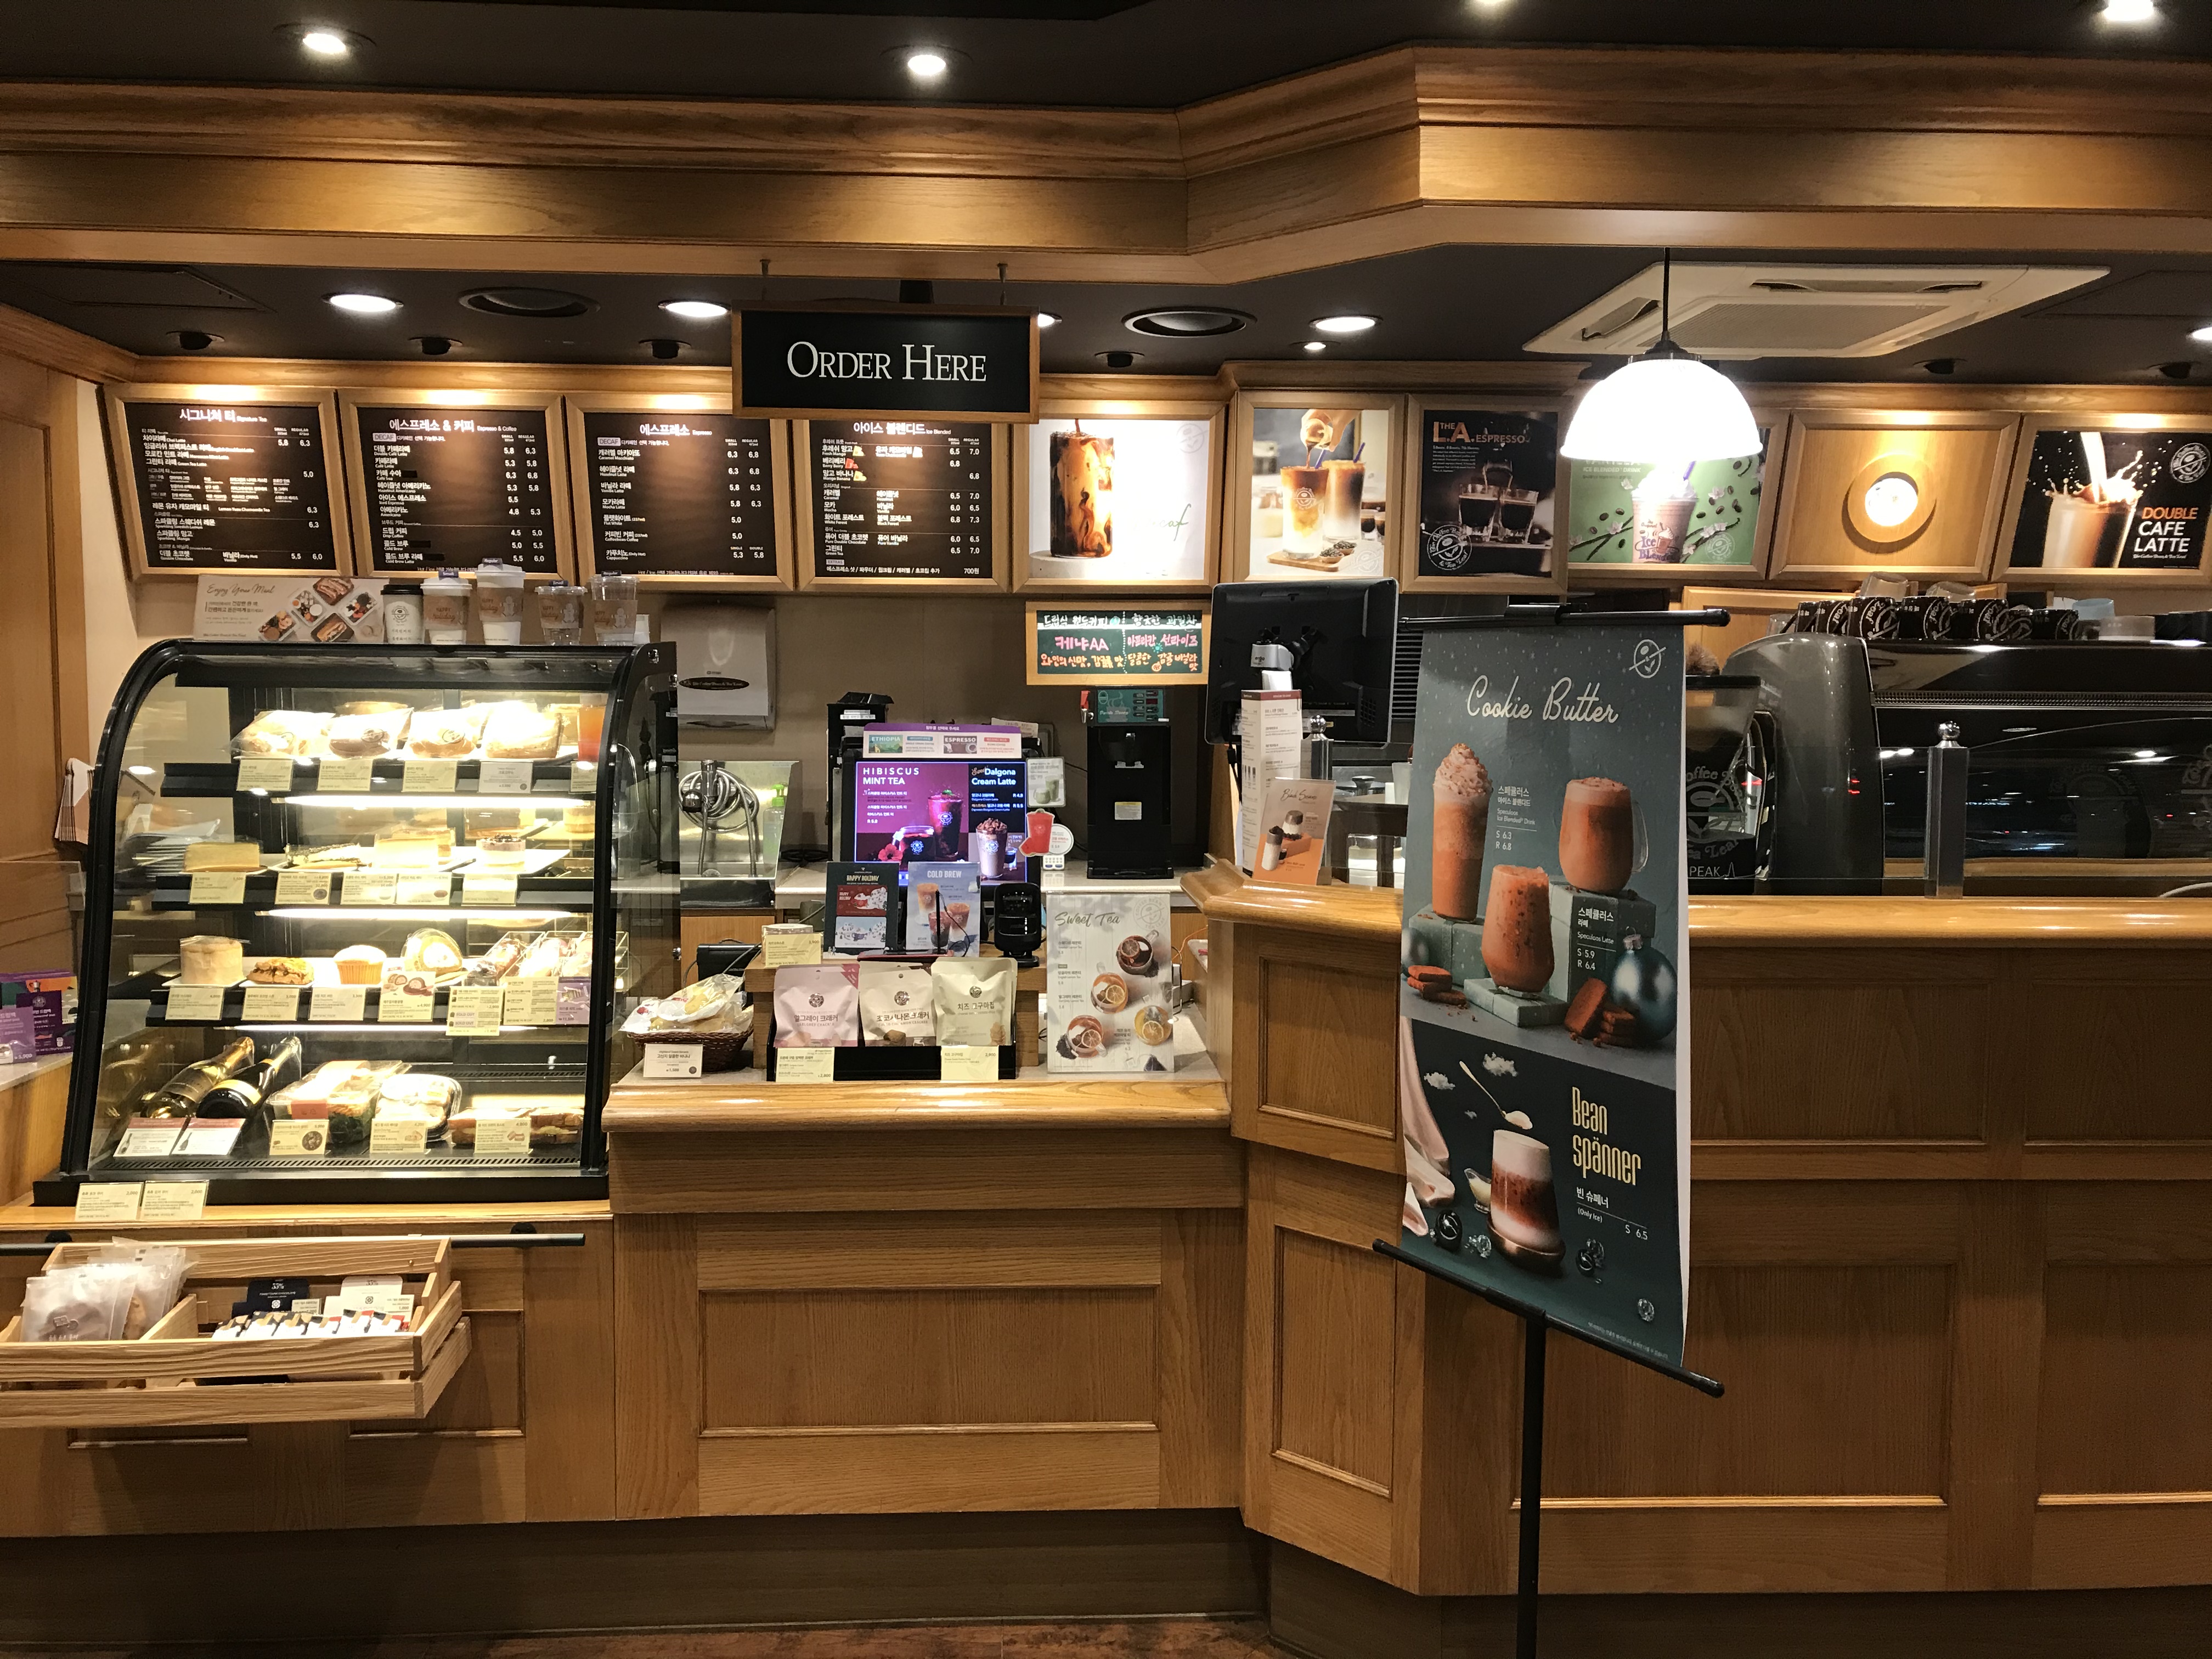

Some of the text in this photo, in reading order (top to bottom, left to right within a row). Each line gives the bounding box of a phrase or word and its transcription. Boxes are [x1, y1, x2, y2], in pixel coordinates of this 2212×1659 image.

[787, 342, 986, 381] ORDER HERE
[180, 409, 235, 422] 시그니처 티
[389, 419, 475, 432] 에스프레소 & 커피
[640, 424, 690, 436] 에스프레소
[854, 422, 883, 434] 아이스
[1476, 435, 1525, 443] ESPRESSO
[2142, 507, 2198, 520] DOUBLE
[2138, 522, 2186, 536] CAFE
[1641, 536, 1656, 548] Ice
[2134, 538, 2190, 552] LATTE
[207, 584, 229, 597] Enjoy
[1043, 615, 1108, 627] 드립식 원두커피
[1166, 614, 1197, 627] 과일차
[1054, 636, 1109, 651] 케냐AA
[1127, 634, 1198, 647] 아프리칸 선라이즈
[1114, 656, 1124, 668] 맛
[1127, 652, 1152, 666] 달콤한
[1175, 653, 1197, 662] 바닐라
[1189, 662, 1198, 671] 맛
[1466, 674, 1619, 724] Cookie Butter
[985, 768, 1015, 776] Dalgona
[1686, 766, 1718, 782] offee
[1497, 797, 1512, 805] 아이스
[1502, 831, 1512, 839] 6.3
[1502, 842, 1512, 850] 6.8
[1689, 866, 1720, 877] PEAK
[1054, 911, 1120, 927] Sweet Tea
[1578, 907, 1614, 922] 스페큘러스
[1577, 918, 1589, 928] 라떼
[1577, 931, 1601, 942] Speculoos
[1584, 950, 1595, 959] 5.9
[1577, 960, 1596, 970] R 6.4
[1572, 1086, 1607, 1135] Bean
[1572, 1134, 1641, 1186] spänner
[1576, 1187, 1609, 1209] 빈 슈페너
[1577, 1207, 1603, 1223] (Only Ice)
[1625, 1224, 1648, 1240] S 6.5
